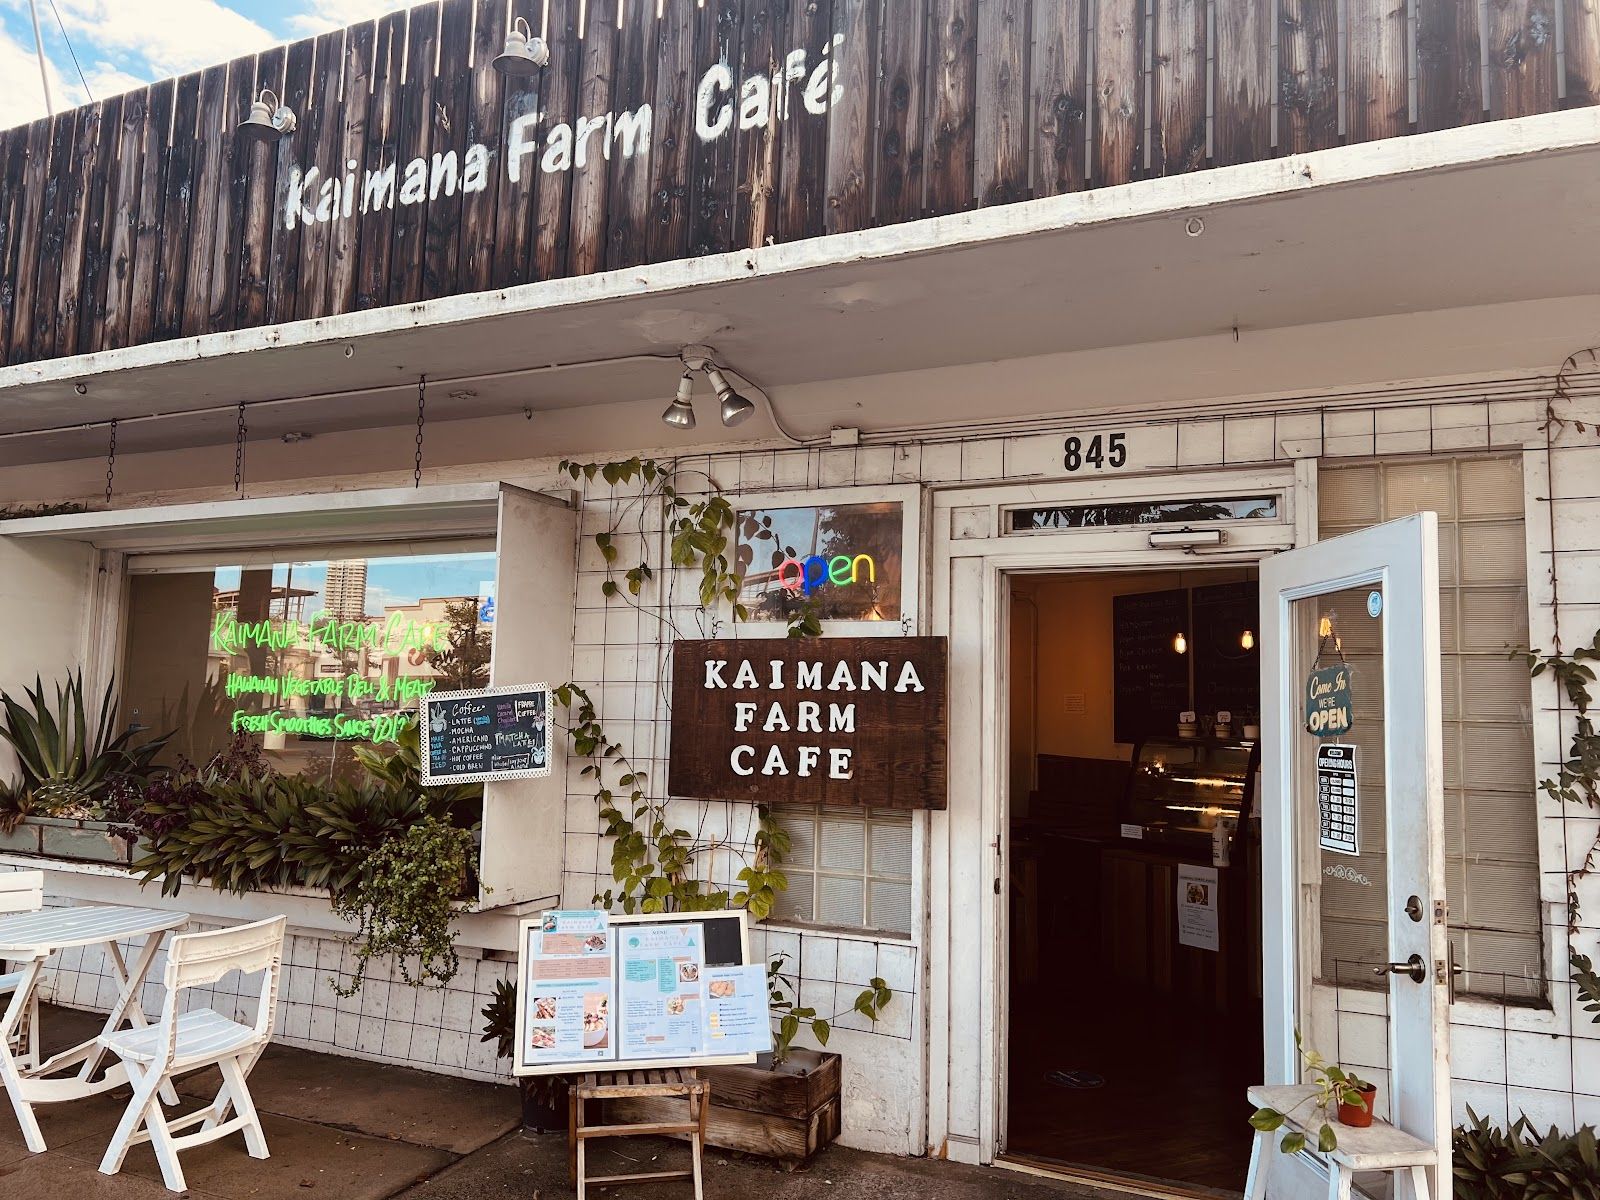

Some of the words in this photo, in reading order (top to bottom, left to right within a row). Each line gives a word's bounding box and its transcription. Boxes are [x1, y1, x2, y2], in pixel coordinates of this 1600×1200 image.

[284, 142, 489, 231] Kaimana
[506, 103, 653, 184] Farm
[696, 33, 846, 142] Café
[1063, 432, 1128, 472] 845
[778, 553, 875, 596] open
[211, 611, 301, 656] KAIMANA
[308, 608, 379, 653] FARM
[281, 670, 344, 700] VEGETABLE
[347, 673, 374, 698] DELI
[375, 674, 390, 703] &
[704, 659, 925, 693] KAIMANA
[1310, 676, 1332, 699] Come
[1334, 671, 1347, 692] In
[451, 717, 473, 726] LATTE
[452, 701, 484, 717] Coffee
[734, 701, 856, 733] FARM
[1309, 706, 1348, 731] OPEN
[334, 712, 373, 738] SINCE
[451, 727, 474, 735] MOCHA
[451, 735, 489, 745] AMERICANO
[462, 753, 484, 761] COFFEE
[730, 744, 853, 780] CAFE
[1318, 758, 1337, 768] OPENING
[1336, 759, 1353, 770] HOURS
